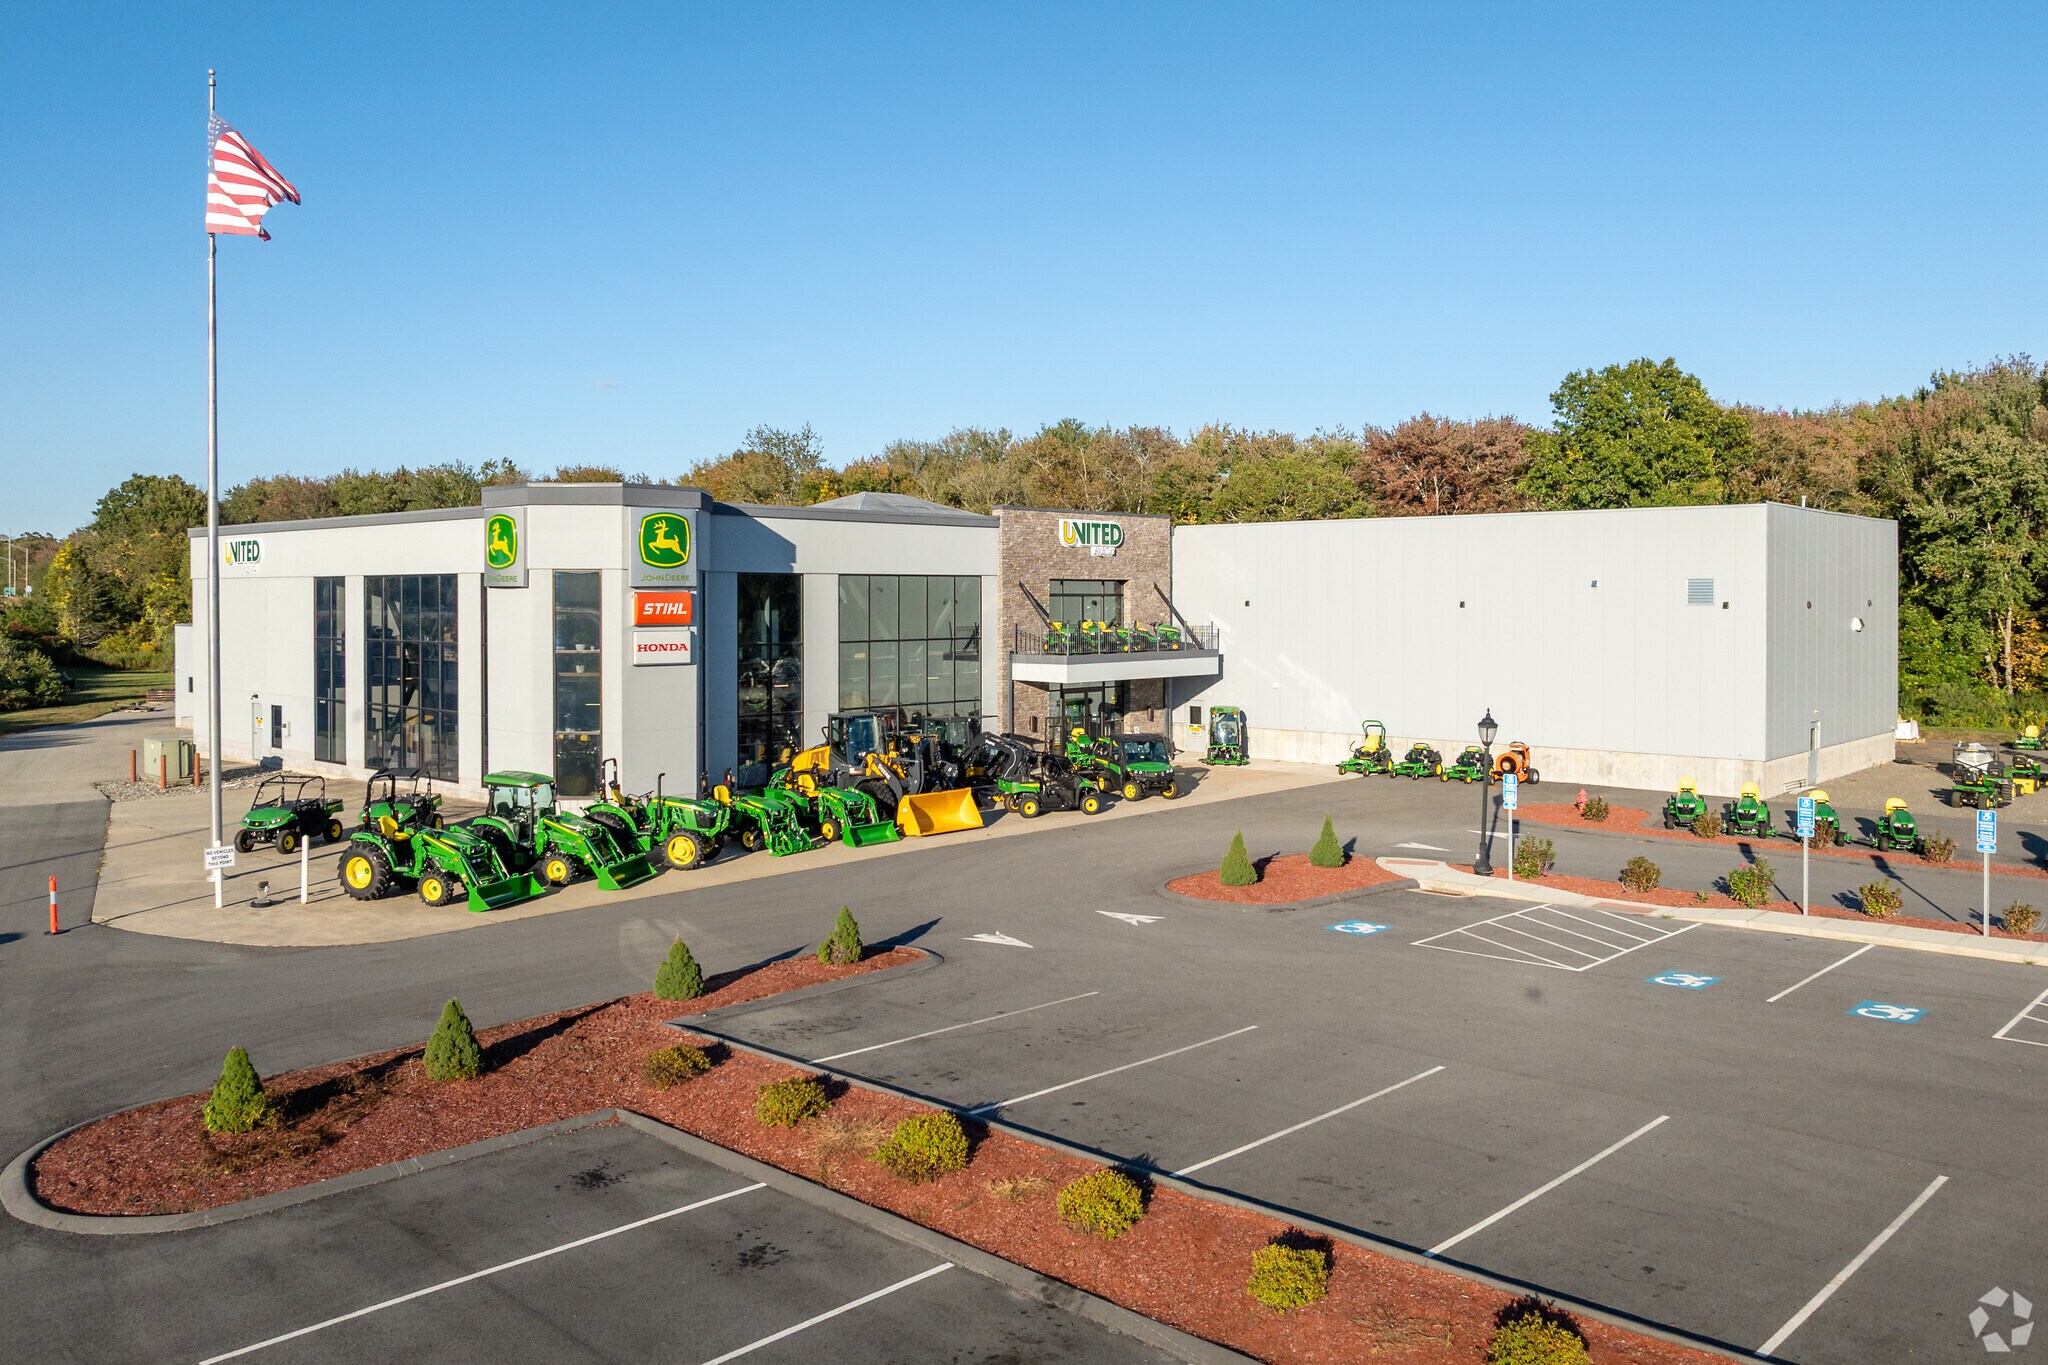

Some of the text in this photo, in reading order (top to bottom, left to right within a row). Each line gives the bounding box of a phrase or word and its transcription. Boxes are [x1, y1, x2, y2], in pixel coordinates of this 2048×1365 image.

[1063, 521, 1123, 545] UNITED
[224, 540, 260, 563] UNITED
[498, 574, 518, 583] DEERE
[641, 573, 690, 582] JOHN DEERE
[643, 602, 687, 615] STIHL
[636, 643, 689, 653] HONDA
